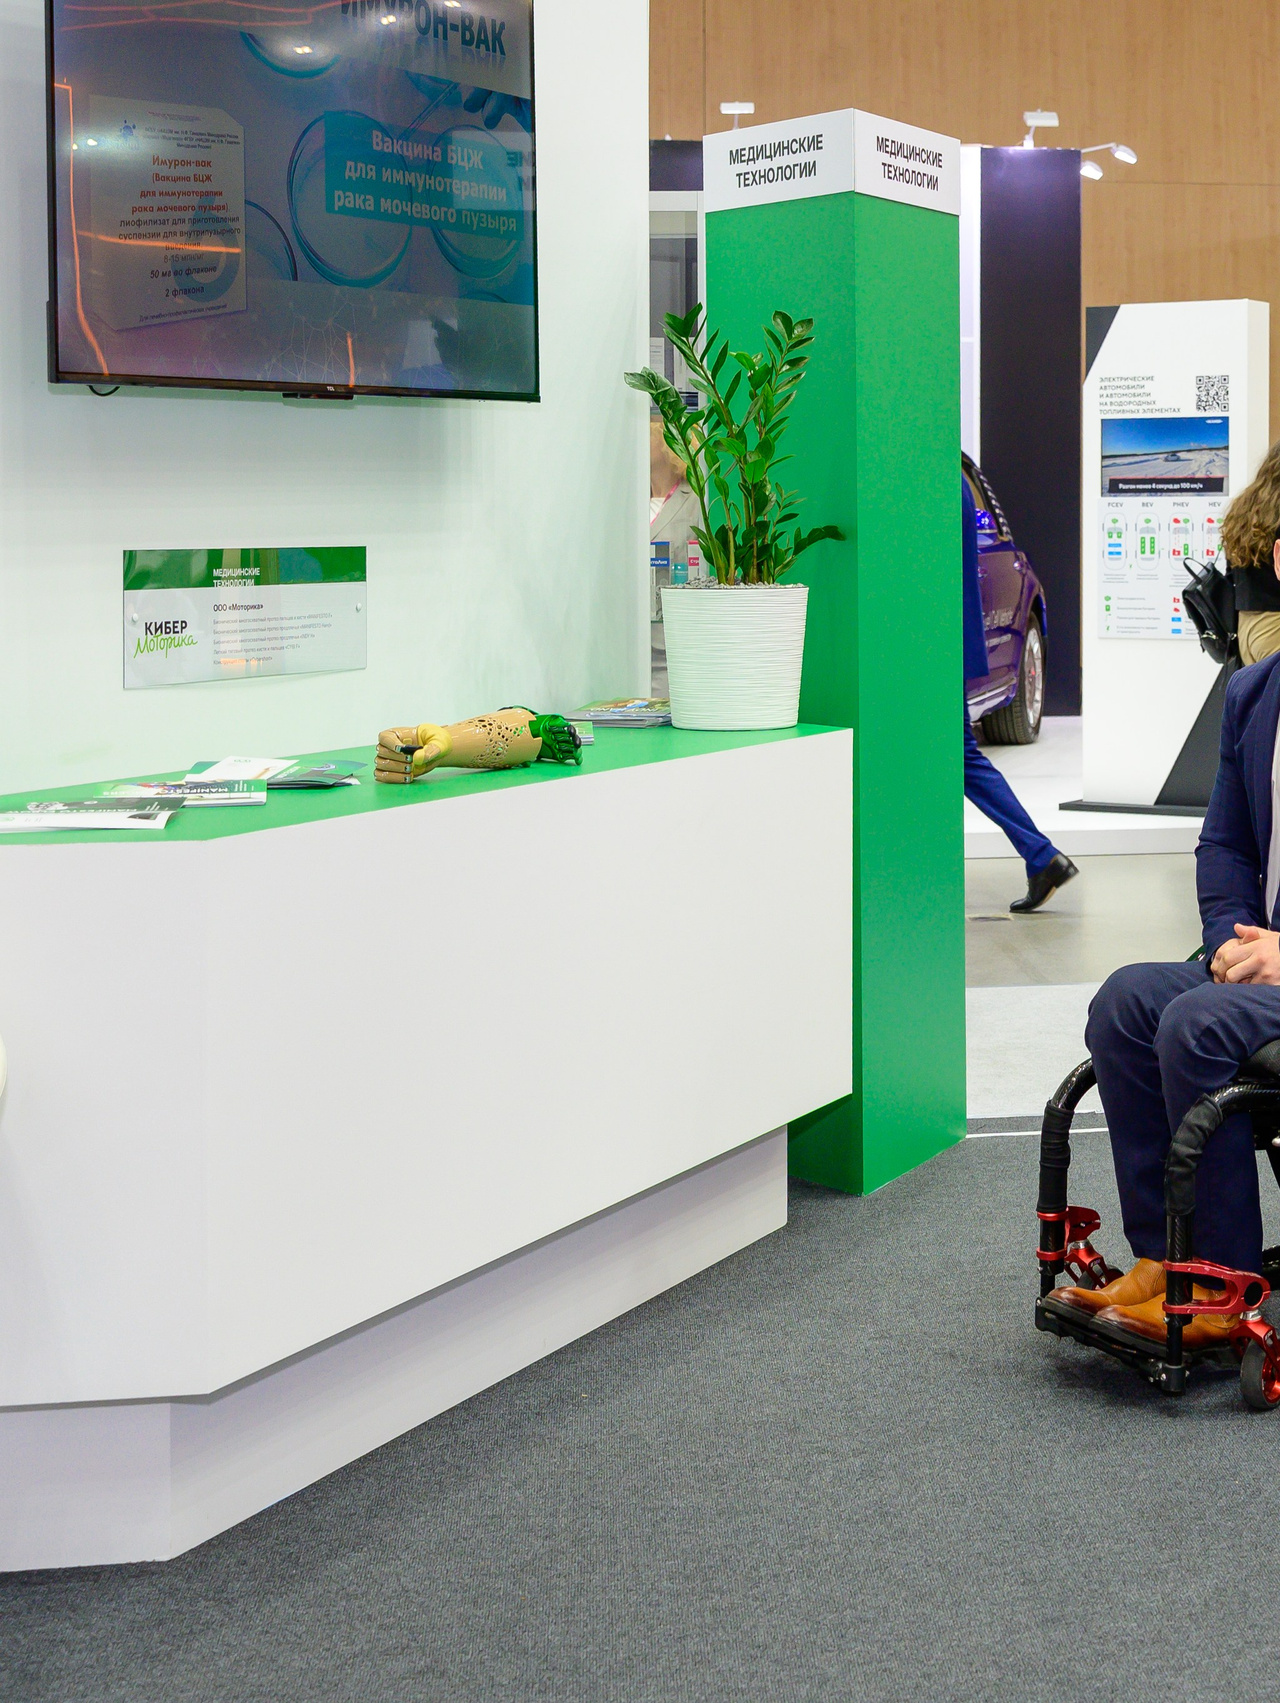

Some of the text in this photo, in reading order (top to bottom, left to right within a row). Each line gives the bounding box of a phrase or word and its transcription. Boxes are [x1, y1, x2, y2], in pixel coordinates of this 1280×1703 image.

[372, 129, 442, 162] Вакцина
[447, 145, 484, 171] БЦЖ
[729, 134, 823, 166] МЕДИЦИНСКИЕ
[876, 135, 943, 168] МЕДИЦИНСКИЕ
[152, 155, 212, 169] Имурон-вак
[152, 173, 212, 183] (Вакцина БЦЖ
[345, 160, 506, 202] для иммунотерапии
[736, 160, 817, 189] ТЕХНОЛОГИИ
[881, 162, 939, 192] ТЕХНОЛОГИИ
[140, 190, 223, 198] для иммунотерапии
[132, 205, 153, 215] рака
[334, 190, 517, 234] рака мочевого пузыря
[172, 218, 185, 226] для
[163, 230, 177, 239] для
[165, 286, 204, 298] 2 флакона
[1099, 375, 1155, 383] ЭЛЕКТРИЧЕСКИЕ
[213, 567, 260, 578] МЕДИЦИНСКИЕ
[212, 579, 255, 588] ТЕХНОЛОГИИ
[213, 603, 264, 612] ООО «Моторика»
[144, 620, 188, 636] КИБЕР
[133, 633, 198, 659] Моторика
